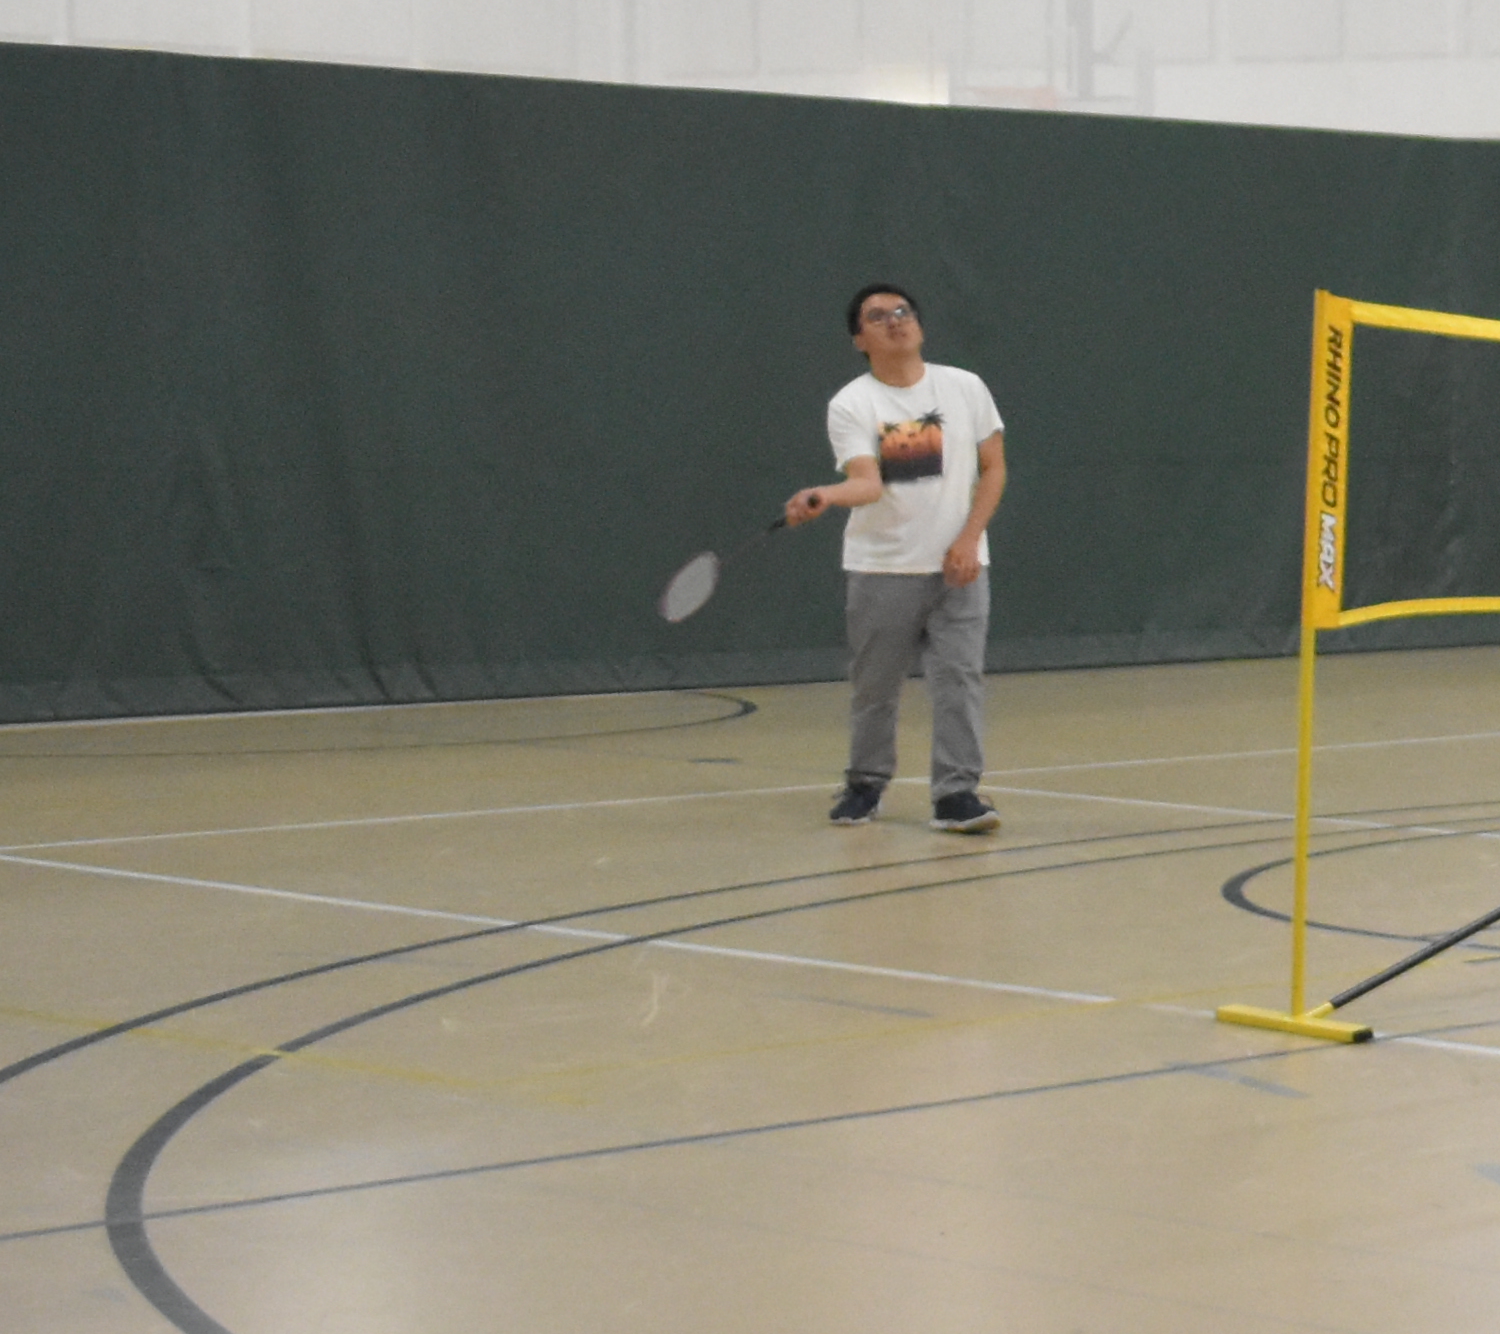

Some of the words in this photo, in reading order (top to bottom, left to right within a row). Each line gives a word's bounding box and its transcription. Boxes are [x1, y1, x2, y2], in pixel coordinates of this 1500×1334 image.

[1324, 326, 1343, 429] RHINO
[1321, 432, 1341, 509] PRO
[1317, 511, 1339, 593] MAX
